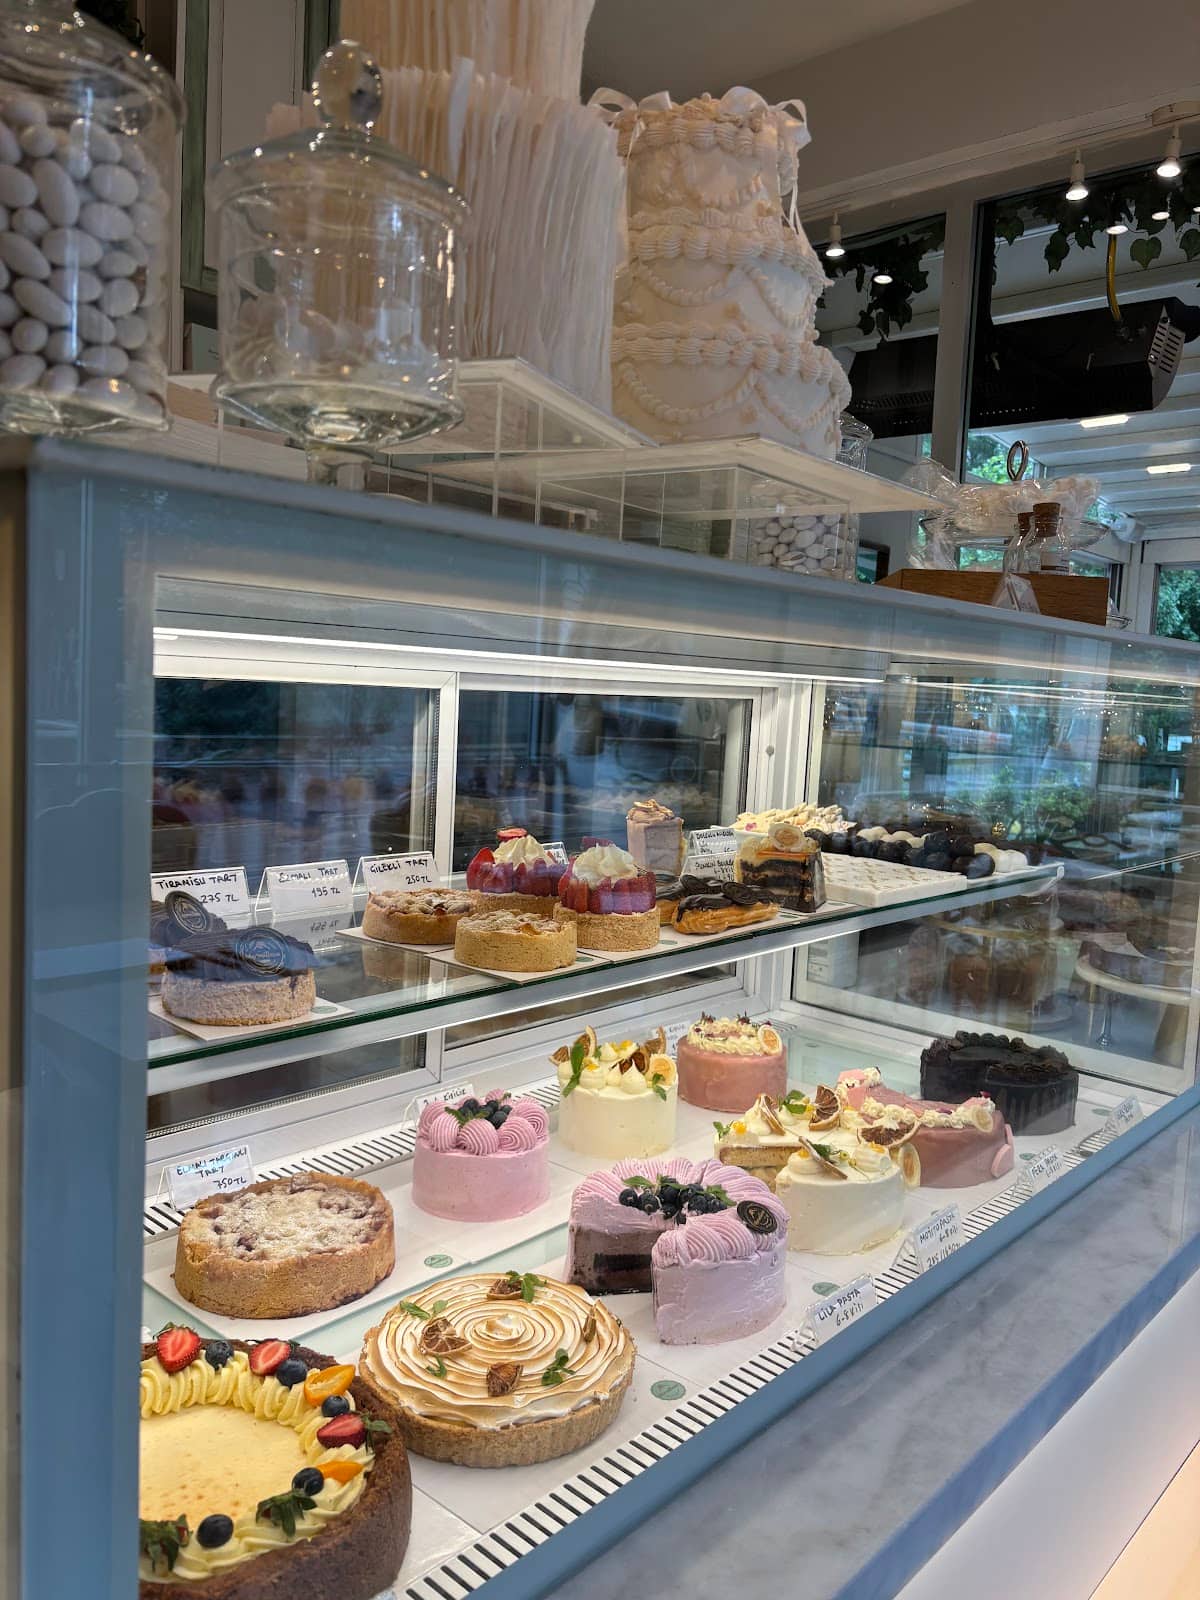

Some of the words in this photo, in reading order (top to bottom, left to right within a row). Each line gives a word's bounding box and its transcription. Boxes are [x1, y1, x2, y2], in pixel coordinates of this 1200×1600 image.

[405, 859, 428, 868] TART
[318, 867, 338, 877] TART
[208, 873, 237, 884] TART
[312, 886, 328, 898] 195
[199, 893, 221, 904] 275
[225, 894, 240, 902] TL
[837, 1288, 861, 1307] PASTA
